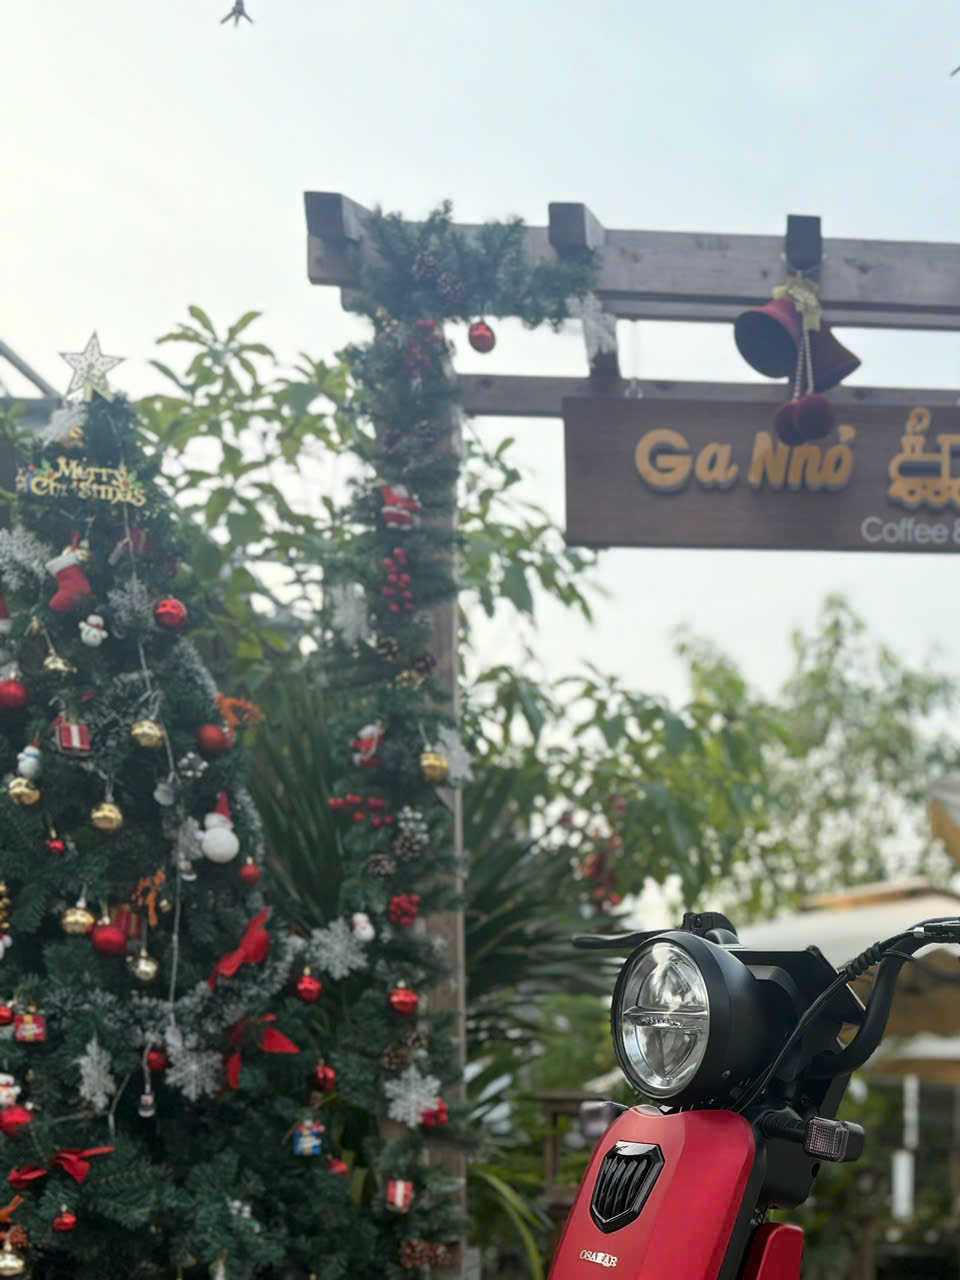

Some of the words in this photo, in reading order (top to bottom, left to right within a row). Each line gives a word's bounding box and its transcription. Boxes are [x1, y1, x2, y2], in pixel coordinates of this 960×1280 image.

[634, 428, 739, 489] Ga
[860, 516, 950, 546] Coffee
[579, 1249, 618, 1267] OSAKAR
